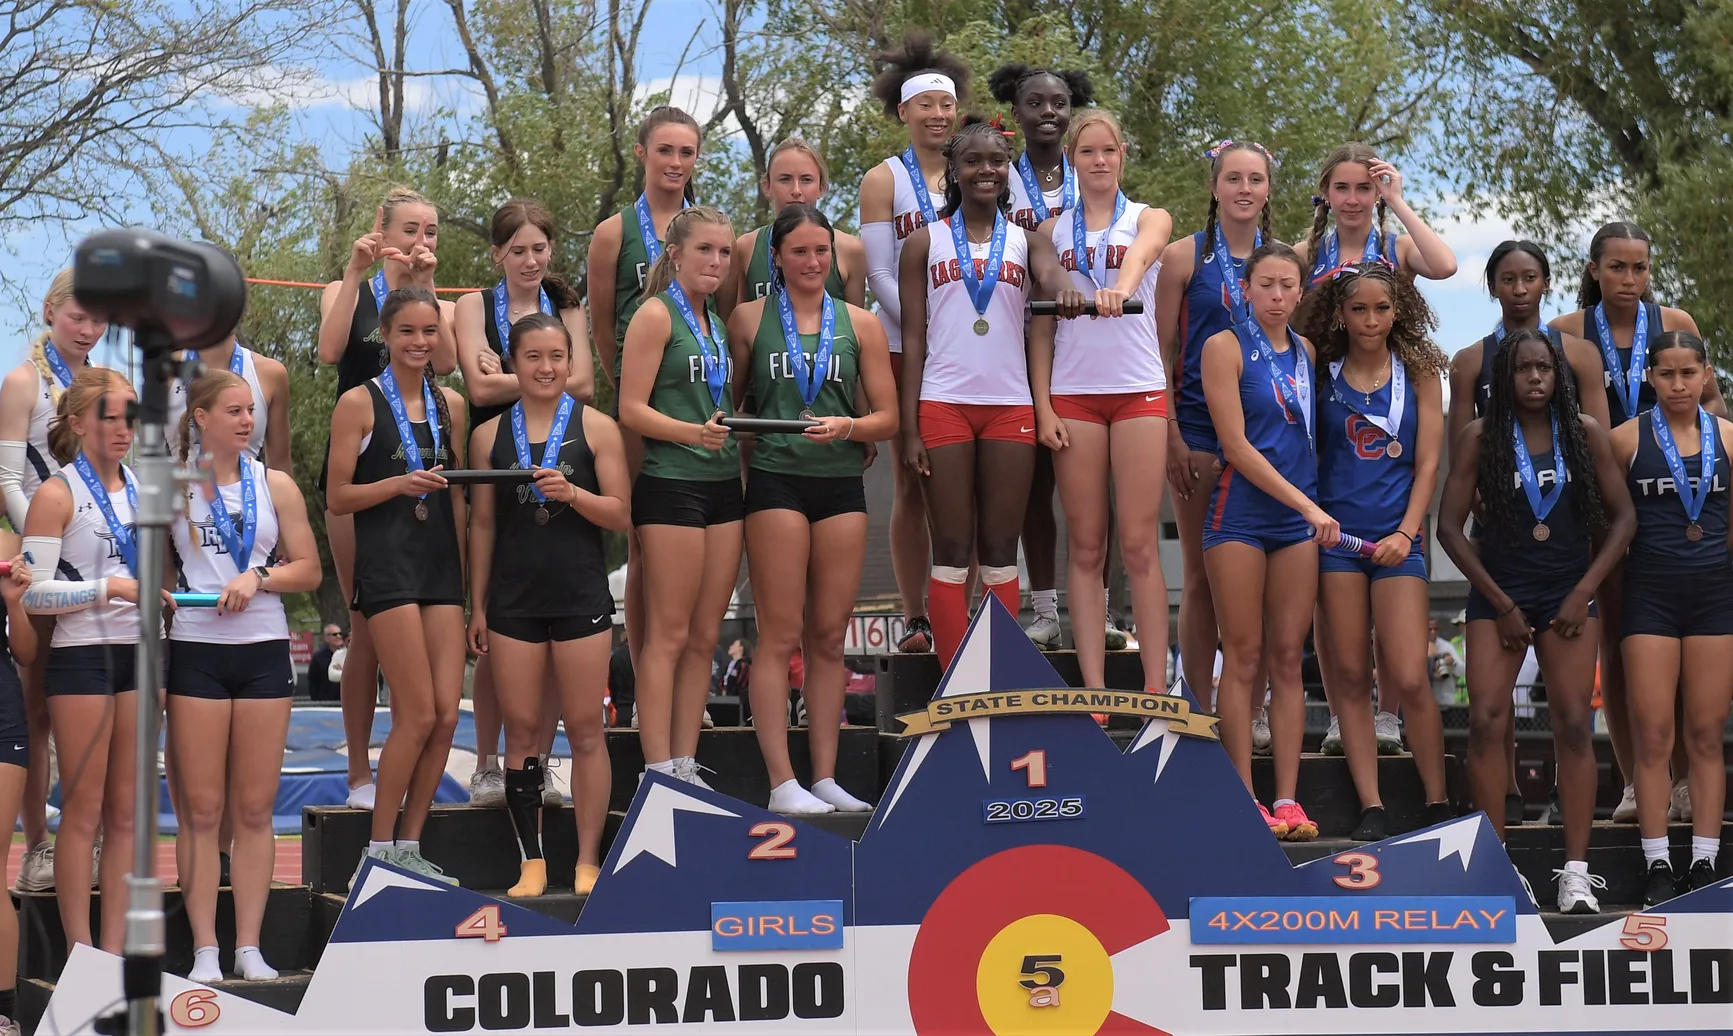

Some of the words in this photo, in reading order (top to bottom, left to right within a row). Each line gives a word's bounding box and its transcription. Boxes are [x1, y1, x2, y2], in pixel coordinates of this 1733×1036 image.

[22, 588, 97, 609] MUSTANGS
[936, 693, 1022, 715] STATE
[1031, 693, 1180, 714] CHAMPION
[1011, 750, 1047, 788] 1
[986, 798, 1084, 821] 2025
[748, 822, 797, 860] 2
[1333, 852, 1382, 890] 3
[456, 905, 507, 943] 4
[715, 914, 836, 937] GIRLS
[1208, 910, 1360, 931] 4X200M
[1374, 909, 1506, 930] RELAY
[1619, 911, 1669, 952] 5
[424, 962, 845, 1033] COLORADO
[1189, 952, 1457, 1011] TRACK
[1471, 950, 1526, 1007] &
[1537, 948, 1733, 1006] FIELD
[170, 988, 221, 1029] 6
